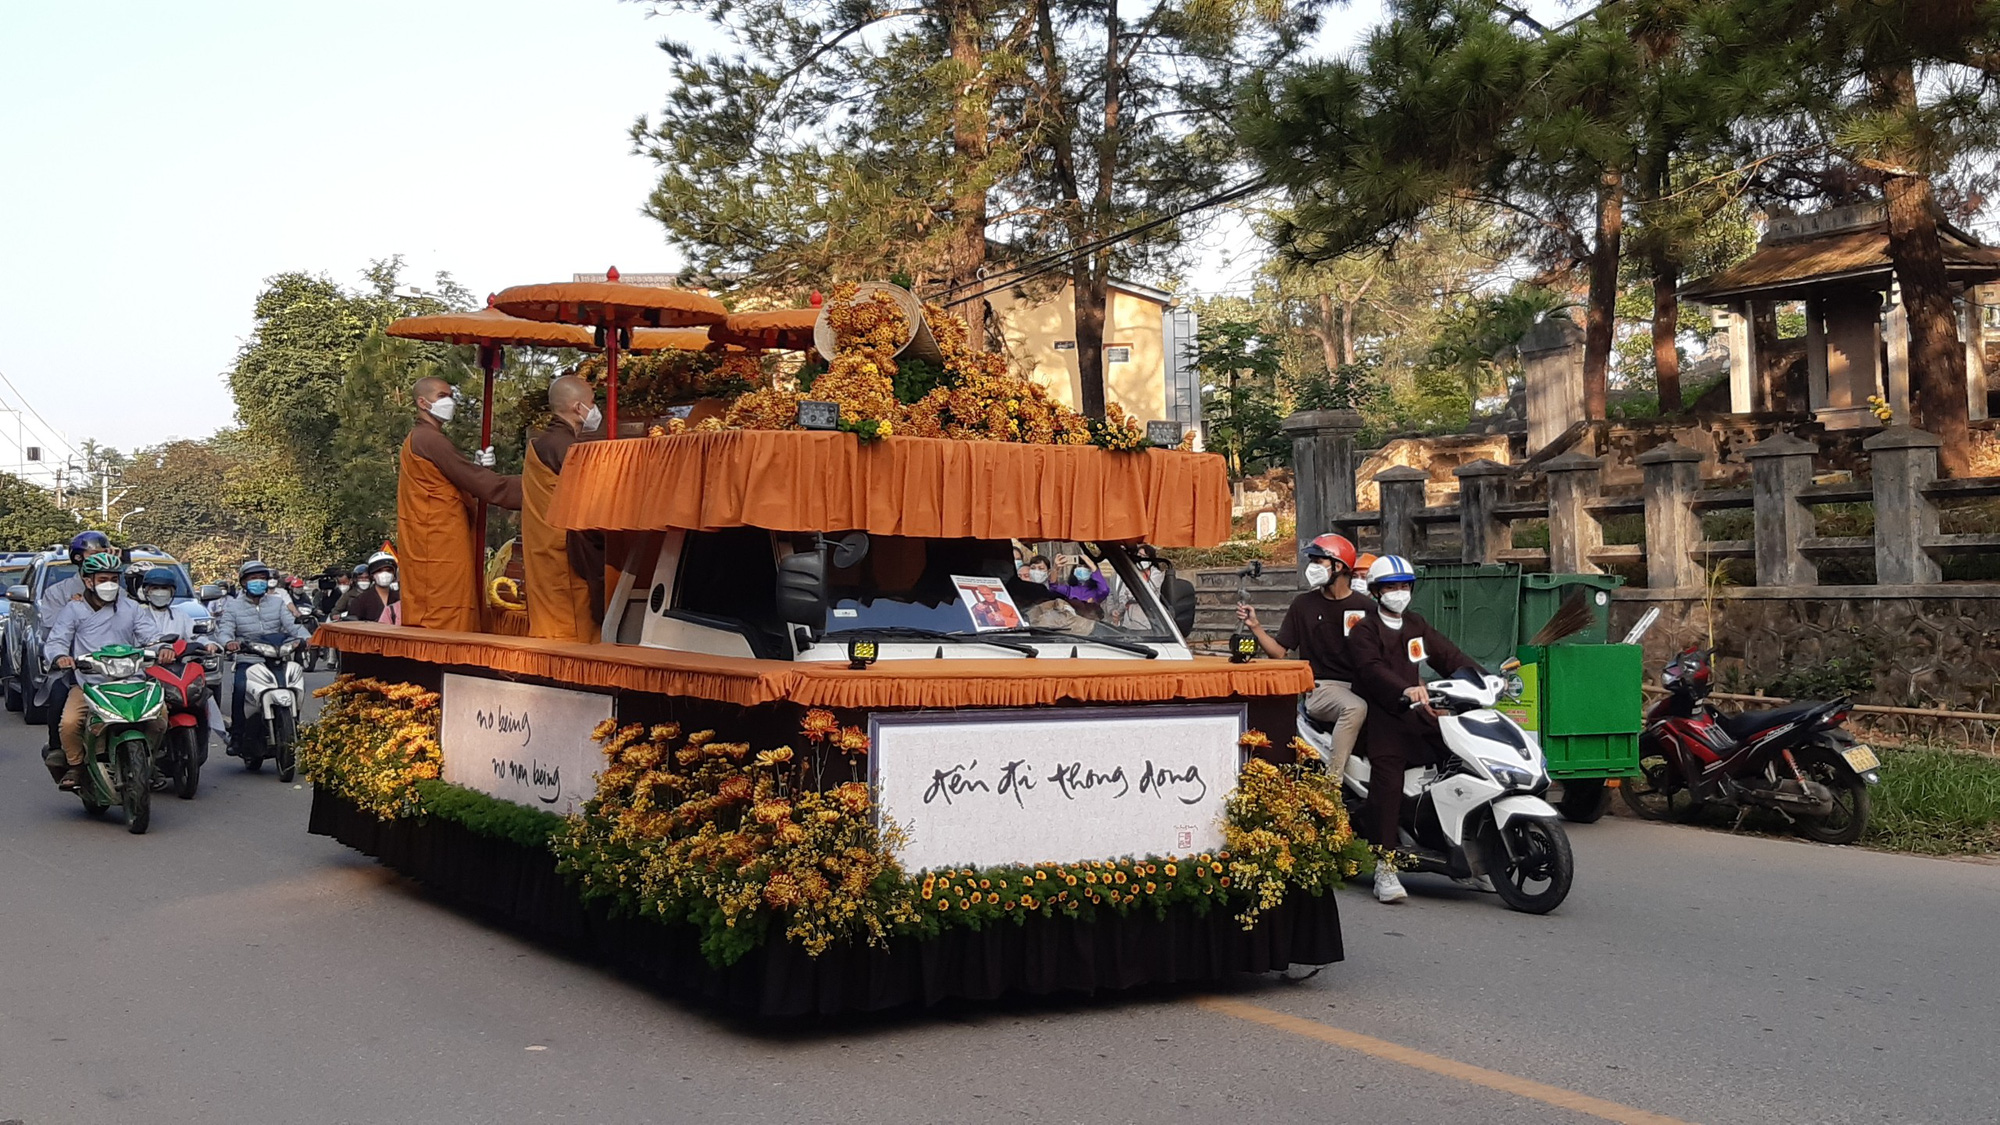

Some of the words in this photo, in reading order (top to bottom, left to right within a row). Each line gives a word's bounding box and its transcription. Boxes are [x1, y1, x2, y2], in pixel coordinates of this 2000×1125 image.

[476, 709, 494, 730] no
[498, 704, 532, 747] being
[491, 757, 506, 779] no
[509, 760, 530, 787] non
[533, 758, 561, 804] being
[923, 758, 990, 805] đến
[997, 759, 1037, 809] đi
[1047, 762, 1130, 800] thong
[1138, 759, 1207, 804] dong
